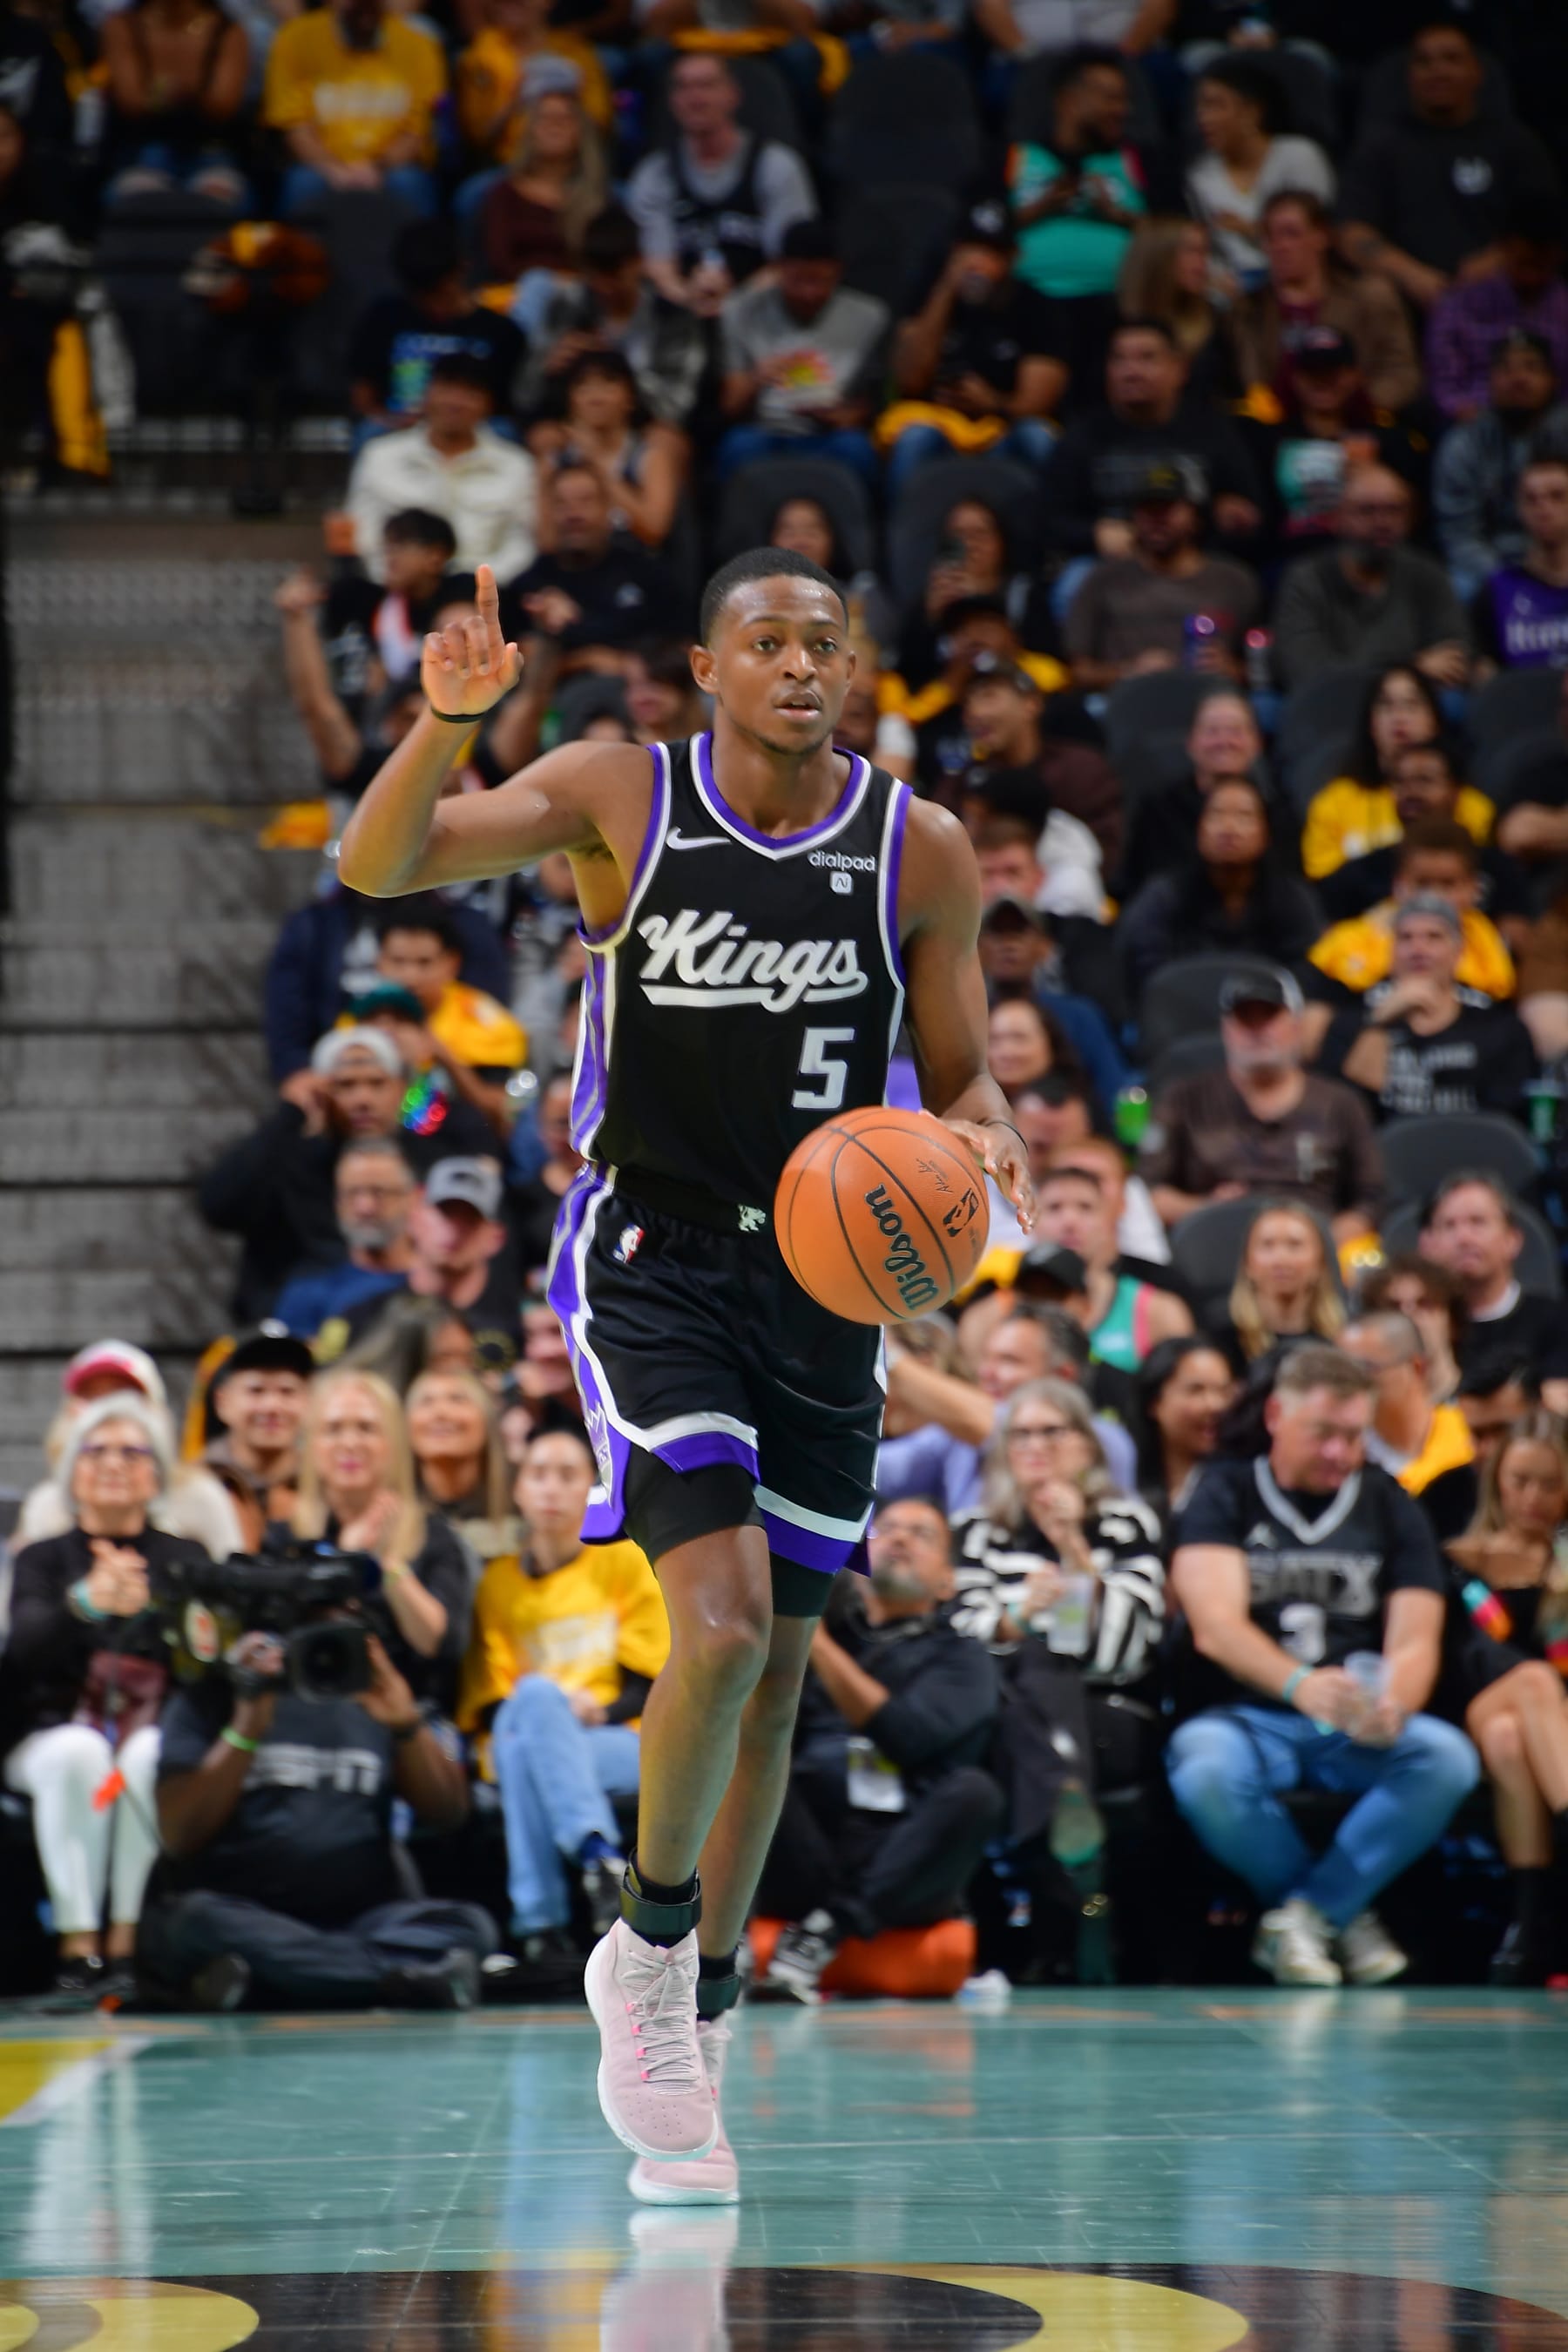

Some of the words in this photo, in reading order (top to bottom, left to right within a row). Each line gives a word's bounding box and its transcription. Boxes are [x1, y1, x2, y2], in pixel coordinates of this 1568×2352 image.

[807, 849, 876, 872] dialpad
[637, 909, 868, 1013] Kings
[792, 1026, 855, 1109] 5
[865, 1183, 939, 1311] Wilson
[1279, 1601, 1327, 1665] 3
